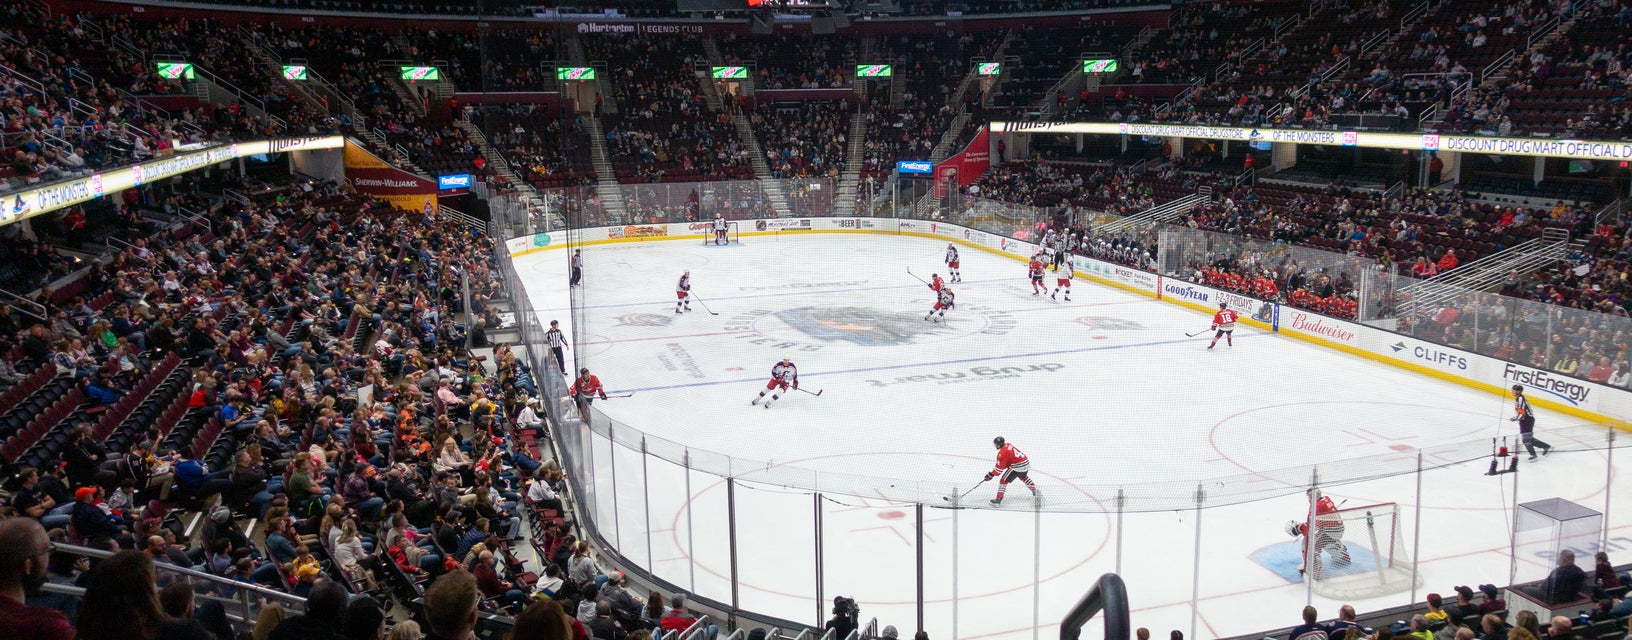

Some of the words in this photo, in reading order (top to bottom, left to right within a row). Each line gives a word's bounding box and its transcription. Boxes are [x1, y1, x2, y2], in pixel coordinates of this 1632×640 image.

[643, 25, 680, 33] LEGENDS
[682, 25, 703, 33] CLUB
[1131, 124, 1155, 134] DISCOUNT
[1156, 125, 1170, 135] DRUG
[1171, 125, 1184, 135] MART
[1186, 126, 1208, 136] OFFICIAL
[1210, 127, 1243, 138] DRUGSTORE
[1273, 131, 1281, 140] OF
[1284, 131, 1295, 141] THE
[1297, 132, 1334, 143] MONSTERS
[1448, 138, 1497, 151] DISCOUNT
[1500, 140, 1530, 152] DRUG
[1532, 141, 1565, 154] MART
[1567, 142, 1618, 157] OFFICIAL
[39, 191, 47, 209] OF
[47, 188, 60, 206] THE
[60, 181, 89, 202] MONSTERS
[1165, 284, 1209, 302] GOODYEAR
[1215, 291, 1229, 304] 1-2-3
[1230, 295, 1253, 310] FRIDAYS
[1221, 314, 1232, 323] 18
[1291, 311, 1354, 341] Budweiser
[1414, 346, 1467, 370] CLIFFS
[1504, 363, 1591, 402] FirstEnergy
